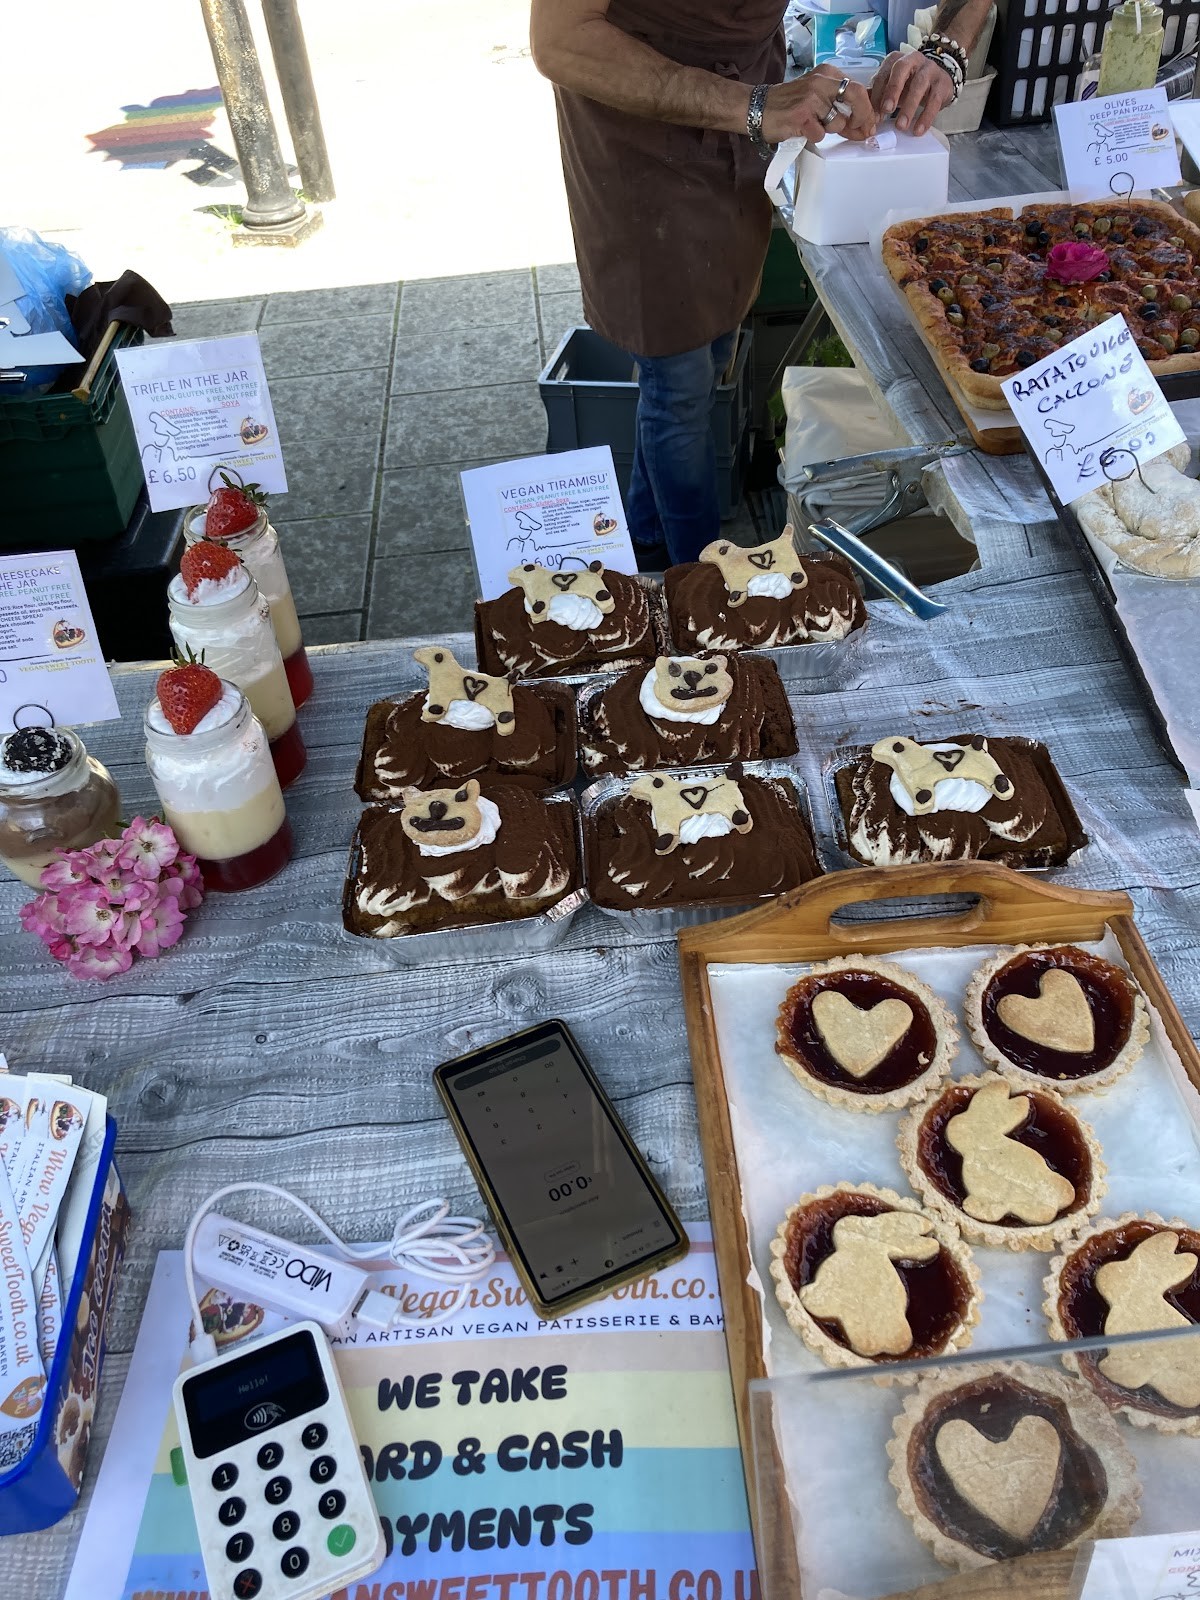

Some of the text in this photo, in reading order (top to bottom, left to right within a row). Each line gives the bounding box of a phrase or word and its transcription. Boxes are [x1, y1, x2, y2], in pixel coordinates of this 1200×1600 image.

[1090, 111, 1112, 121] DEEP
[1113, 107, 1131, 116] PAN
[1132, 103, 1155, 113] PIZZA
[1104, 97, 1137, 110] OLIVES
[1094, 152, 1129, 166] £ 5.00
[131, 370, 249, 396] TRIFLE IN THE JAR
[151, 393, 177, 403] VEGAN,
[177, 389, 204, 399] GLUTEN
[226, 384, 239, 393] NUT
[240, 381, 258, 391] FREE
[212, 393, 239, 402] PEANUT
[240, 389, 258, 399] FREE
[221, 400, 240, 409] SOYA
[148, 466, 196, 484] £ 6.50
[501, 484, 545, 500] VEGAN
[537, 493, 560, 501] PEANUT
[561, 489, 576, 497] FREE
[17, 579, 38, 589] JAR
[18, 586, 50, 595] PEANUT
[51, 583, 72, 591] FREE
[32, 592, 71, 602] NUT FREE
[25, 1141, 44, 1187] ITALIAN
[366, 1324, 454, 1343] ARTISAN
[462, 1321, 529, 1335] VEGAN
[537, 1314, 661, 1331] PATISSERIE
[669, 1314, 681, 1326] &
[238, 1374, 270, 1395] Hello!
[377, 1364, 568, 1411] WE TAKE
[221, 1428, 319, 1485] 1 2 3
[452, 1437, 487, 1476] &
[497, 1429, 624, 1473] CASH
[227, 1461, 328, 1519] 4 5 6
[235, 1495, 337, 1555] 7 8 9
[289, 1553, 301, 1570] 0
